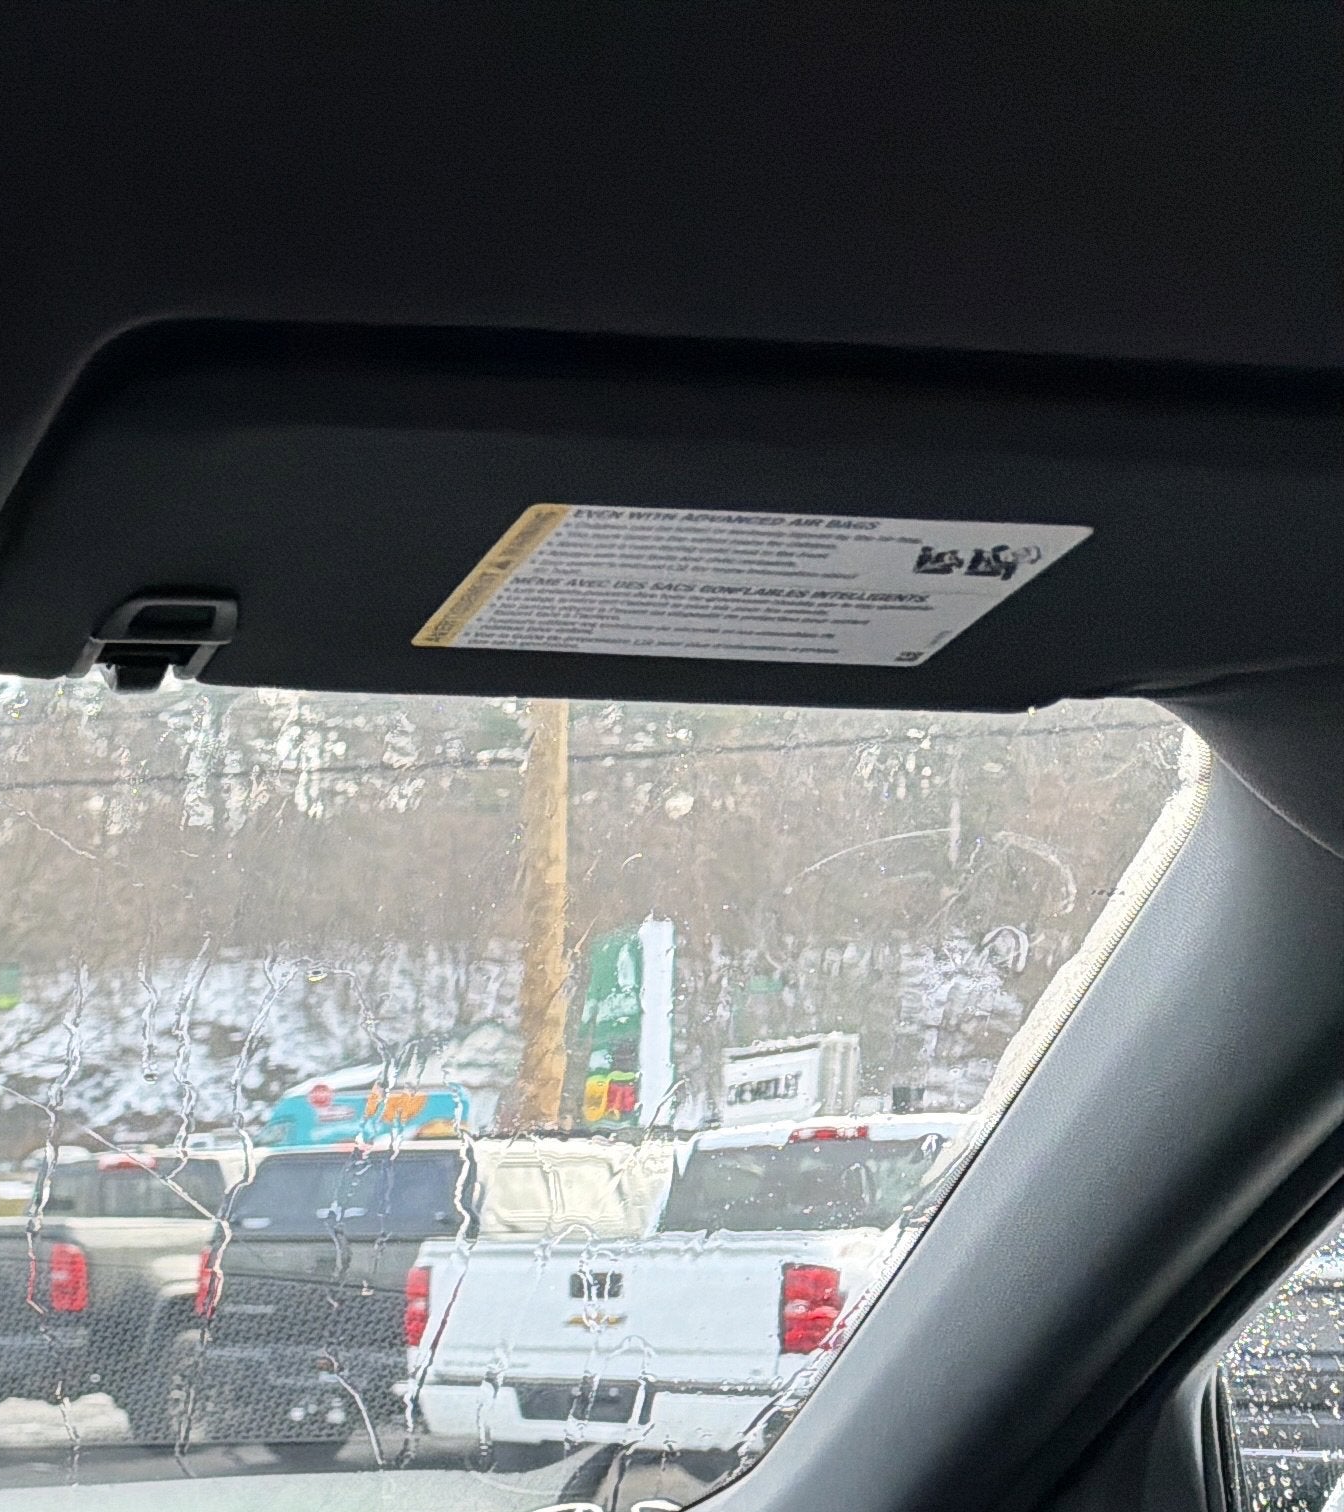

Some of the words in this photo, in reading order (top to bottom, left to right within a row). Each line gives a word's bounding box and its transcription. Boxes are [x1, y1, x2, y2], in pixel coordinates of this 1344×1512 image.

[680, 513, 786, 525] ADVANCED
[789, 517, 822, 527] AIR
[825, 520, 880, 531] BAGS
